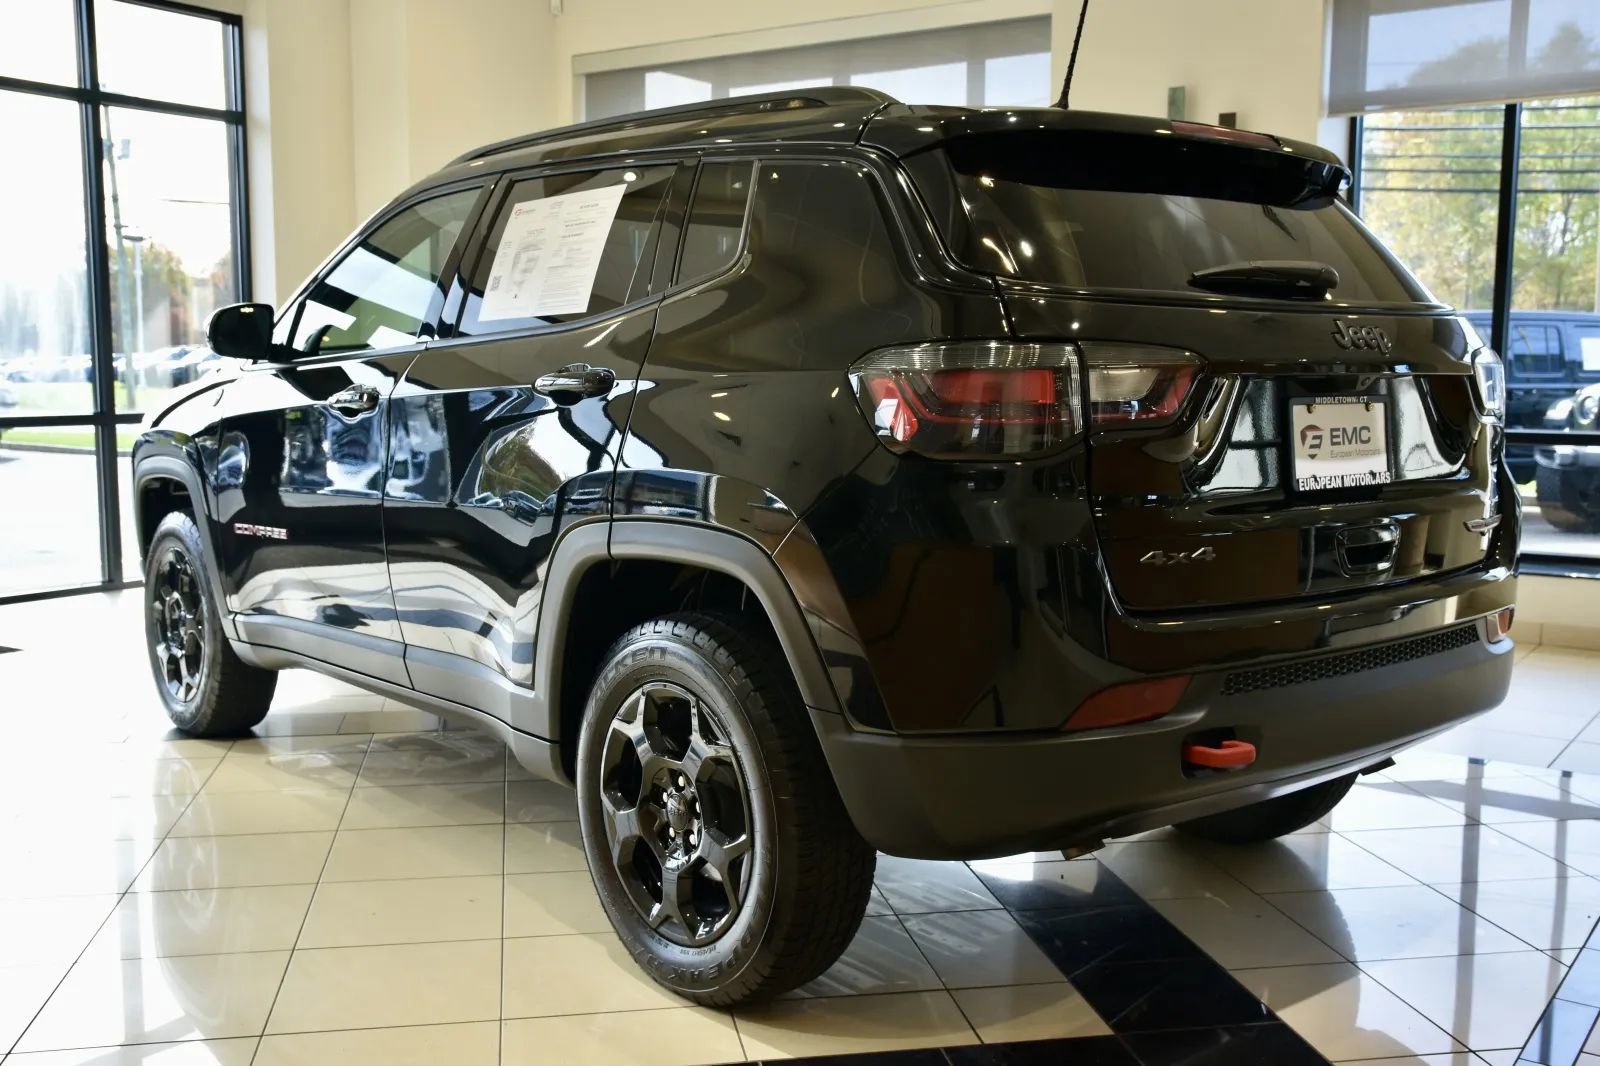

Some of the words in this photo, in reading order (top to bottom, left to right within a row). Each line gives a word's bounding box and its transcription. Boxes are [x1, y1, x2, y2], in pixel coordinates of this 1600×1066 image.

[1332, 320, 1392, 355] Jeep
[1329, 426, 1372, 446] EMC
[1140, 546, 1216, 565] 4x4
